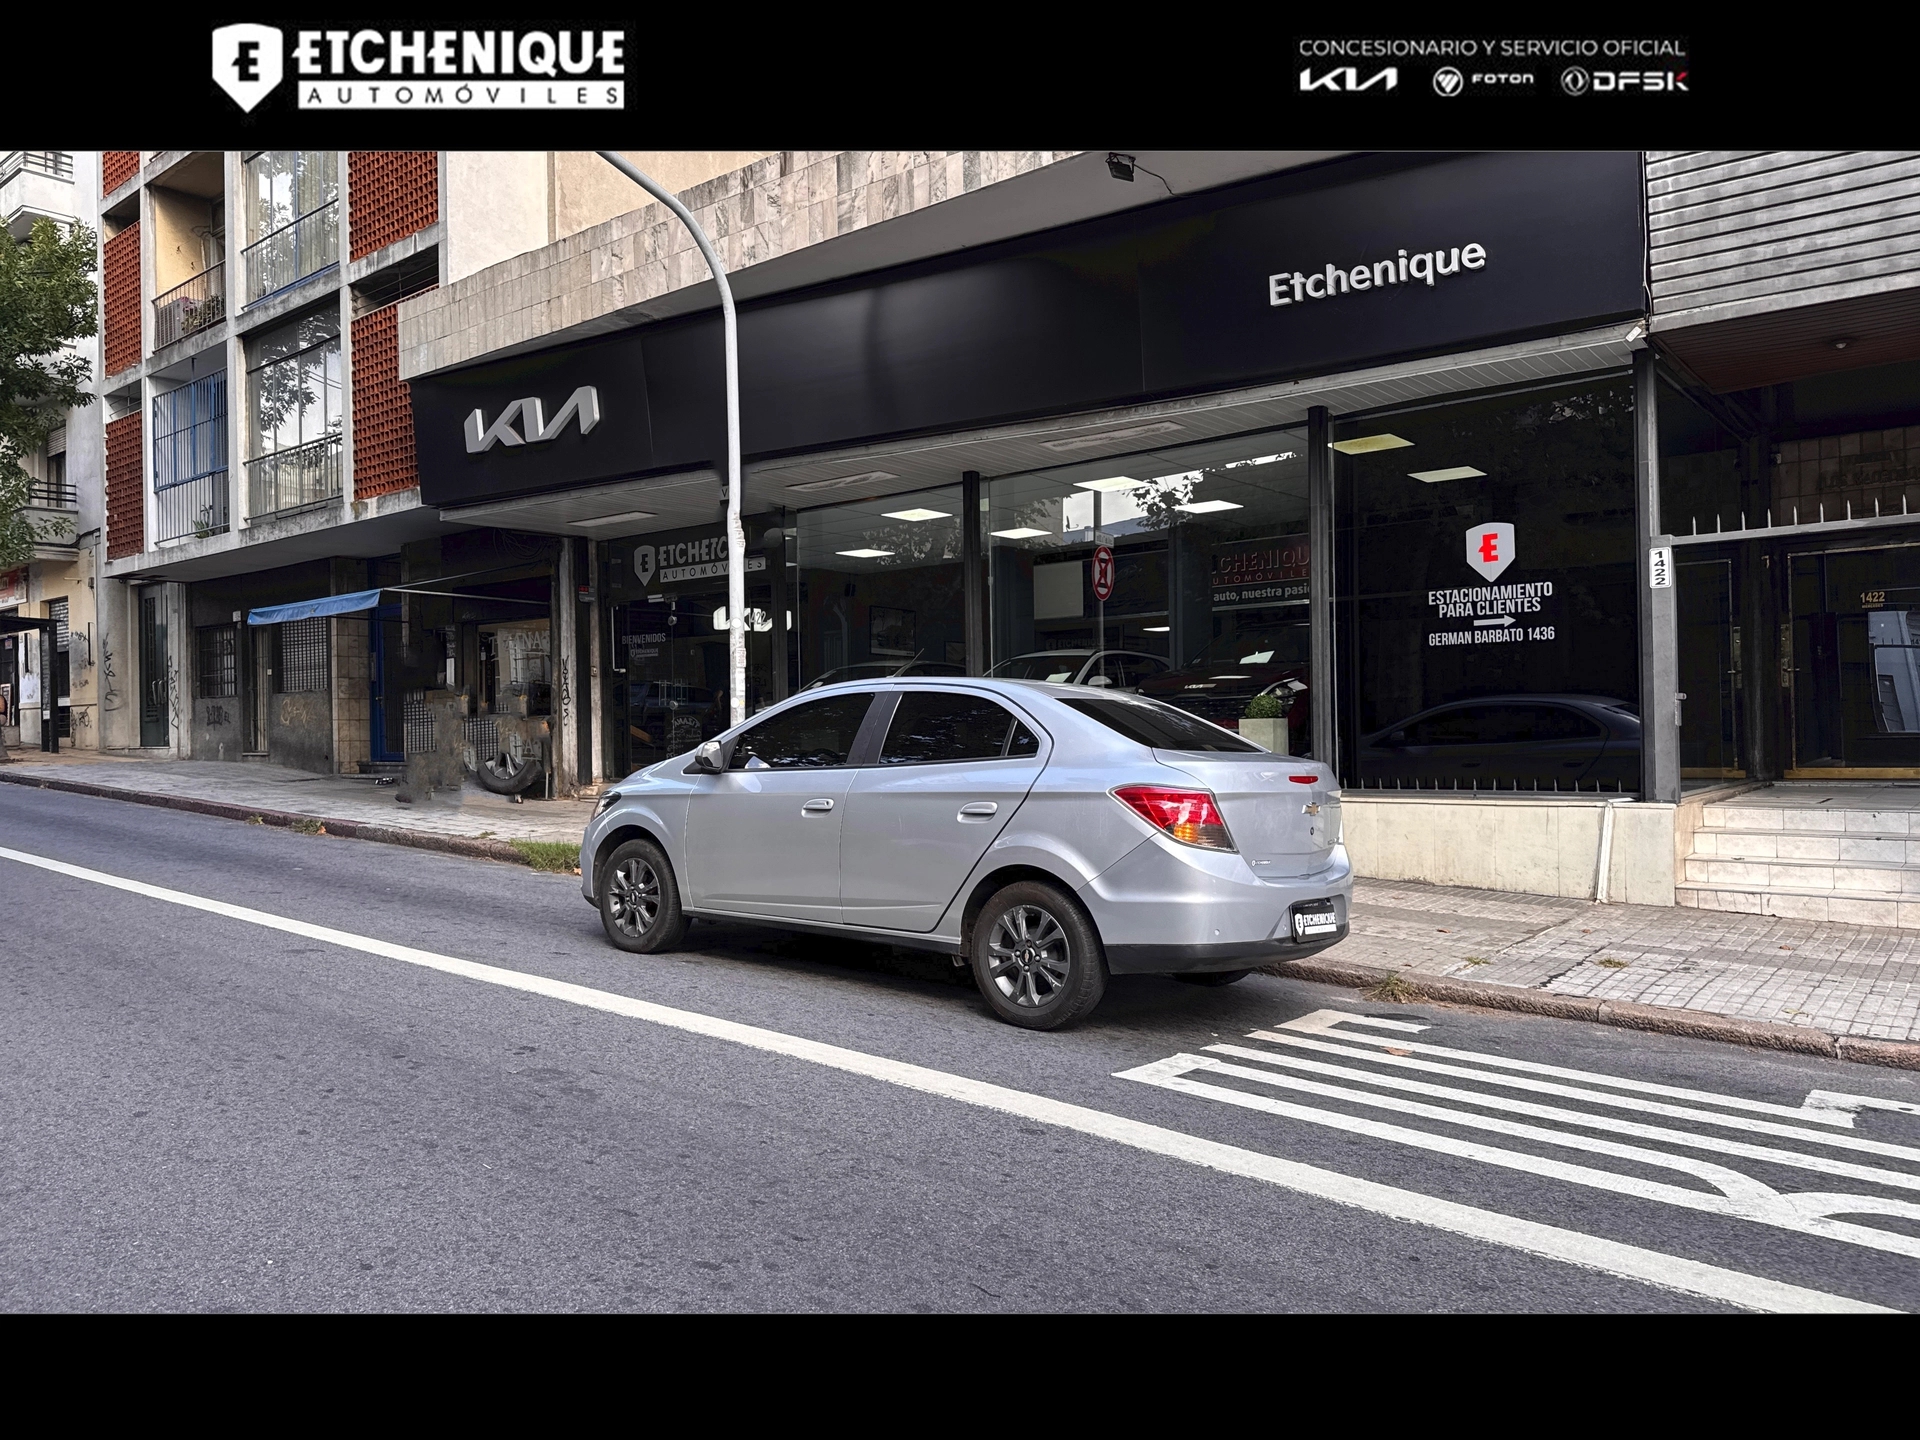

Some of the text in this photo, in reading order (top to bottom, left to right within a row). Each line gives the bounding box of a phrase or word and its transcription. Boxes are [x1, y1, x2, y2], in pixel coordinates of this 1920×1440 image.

[1269, 242, 1487, 307] Etchenique
[464, 385, 600, 453] KIA
[1653, 550, 1666, 586] 1422
[1213, 591, 1240, 602] auto,
[1241, 586, 1282, 599] nuestra
[1428, 581, 1553, 606] ESTACIONAMIENTO
[1860, 591, 1885, 603] 1422
[1439, 597, 1541, 618] PARA CLIENTES
[621, 633, 667, 645] BIENVENIDOS
[1428, 626, 1556, 646] GERMAN BARBATO 1436
